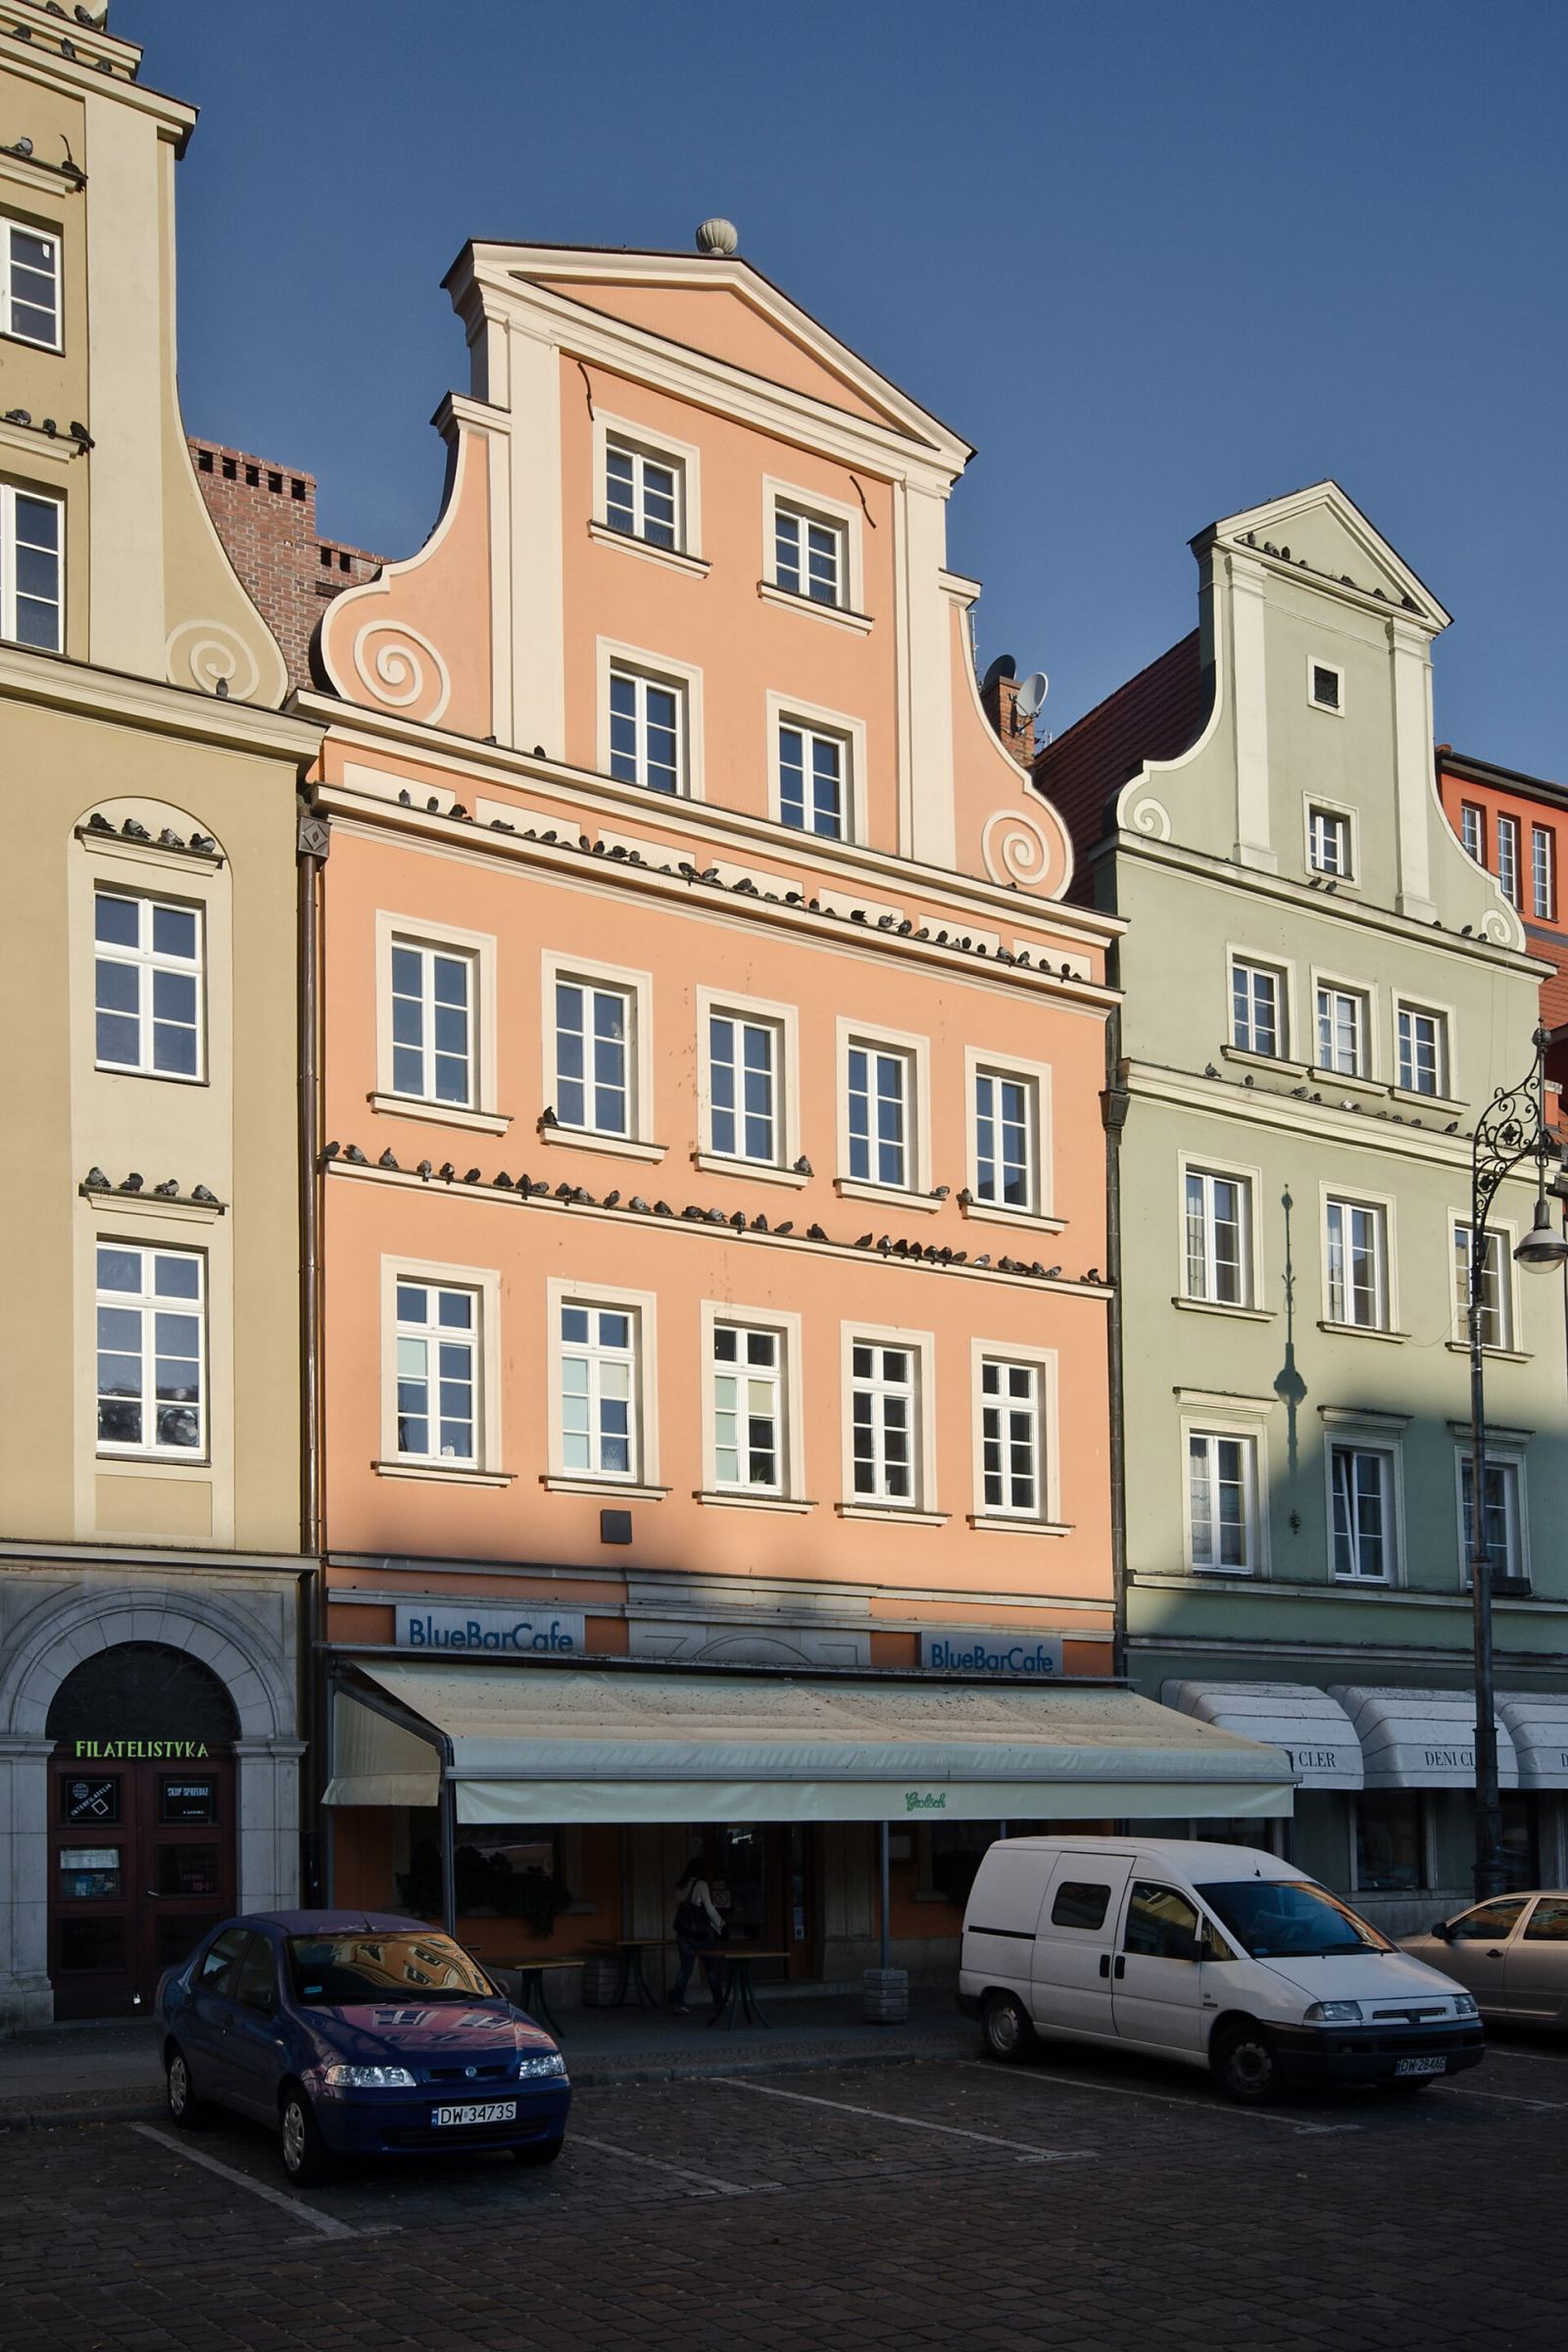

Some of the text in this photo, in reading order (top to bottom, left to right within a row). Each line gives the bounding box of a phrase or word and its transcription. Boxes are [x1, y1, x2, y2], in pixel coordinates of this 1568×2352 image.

[410, 1615, 573, 1651] BlueBarCafe
[931, 1641, 1054, 1672] BlueBarCafe
[75, 1740, 210, 1758] FILATELISTYKA
[1298, 1750, 1337, 1768] CLER
[1425, 1750, 1476, 1767] DENI CL
[905, 1790, 947, 1812] Grolsch
[441, 2104, 514, 2124] DW 3473S
